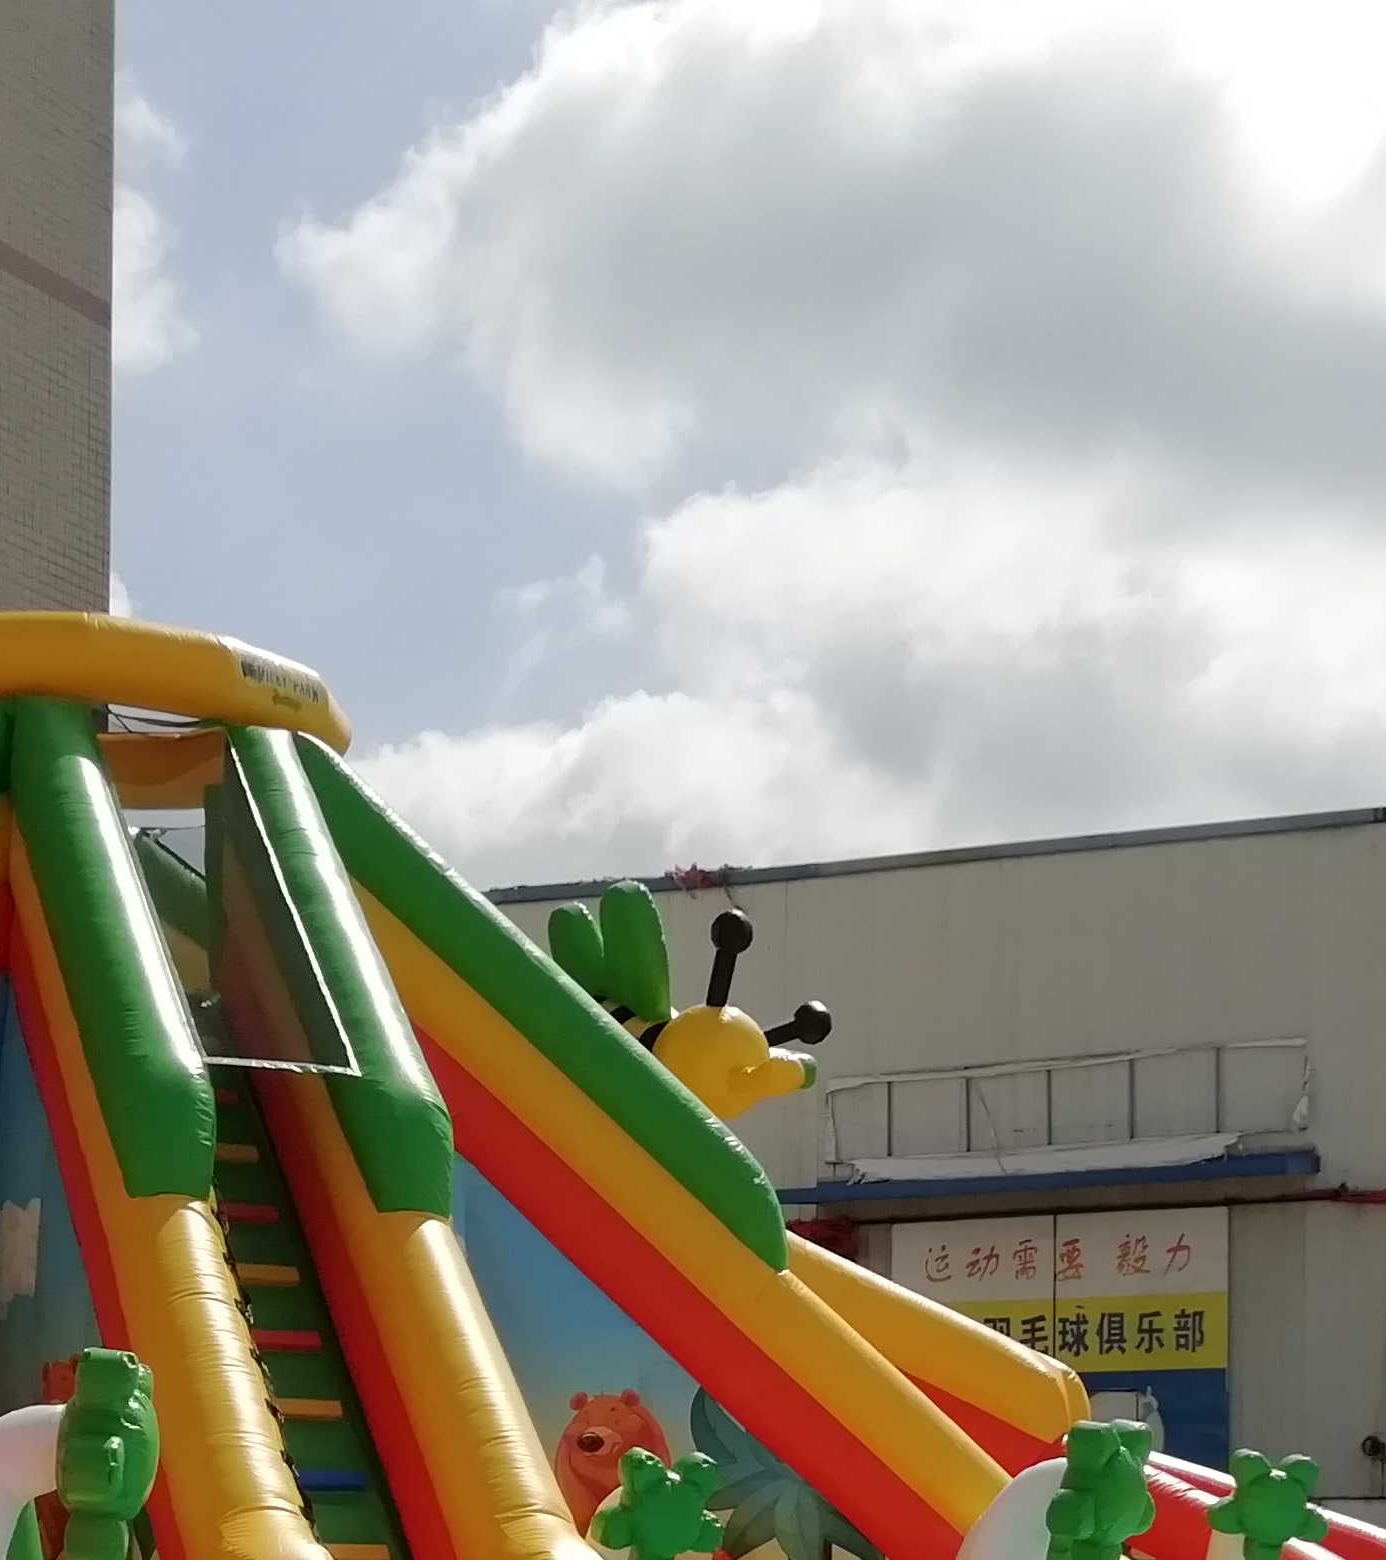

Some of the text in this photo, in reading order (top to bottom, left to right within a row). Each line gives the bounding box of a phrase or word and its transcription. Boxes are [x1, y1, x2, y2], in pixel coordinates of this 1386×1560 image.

[924, 1232, 1192, 1284] 运动需要毅力
